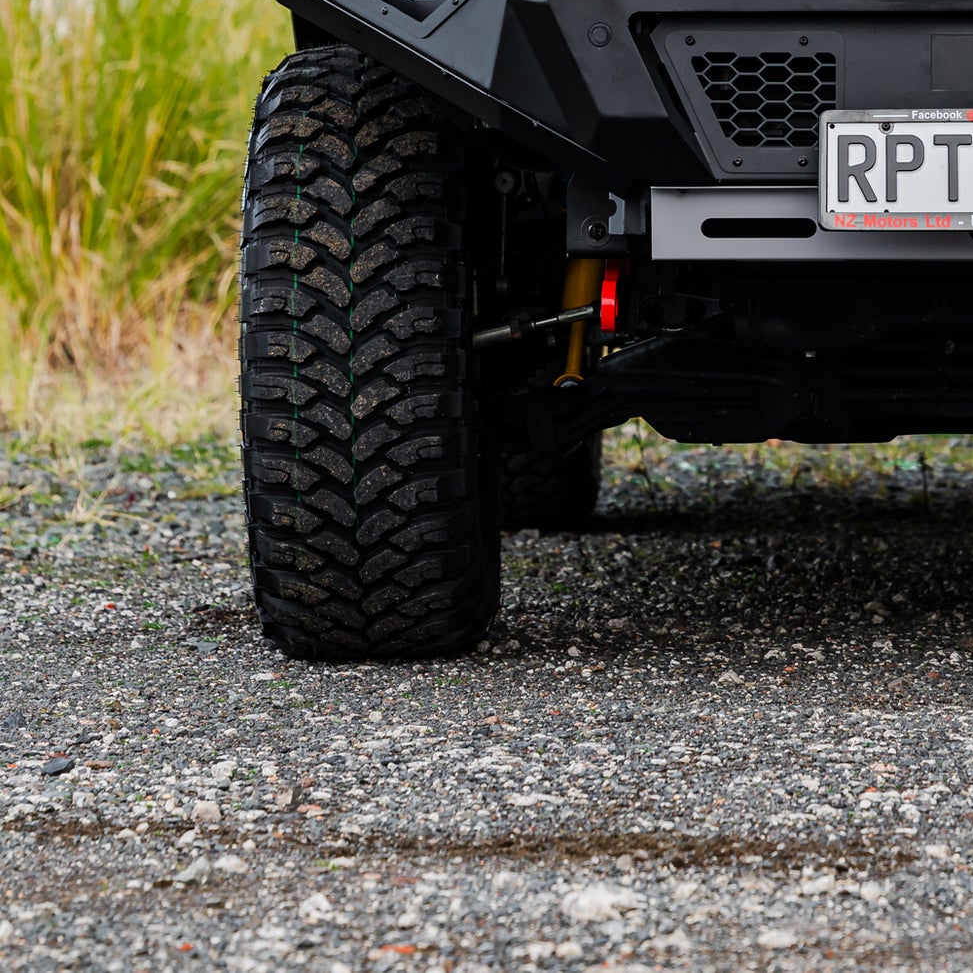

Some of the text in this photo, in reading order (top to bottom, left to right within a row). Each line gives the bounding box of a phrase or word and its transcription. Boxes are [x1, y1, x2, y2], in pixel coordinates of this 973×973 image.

[911, 110, 962, 120] Facebook
[834, 214, 857, 228] NZ
[863, 214, 918, 228] Motors
[925, 214, 951, 228] Ltd
